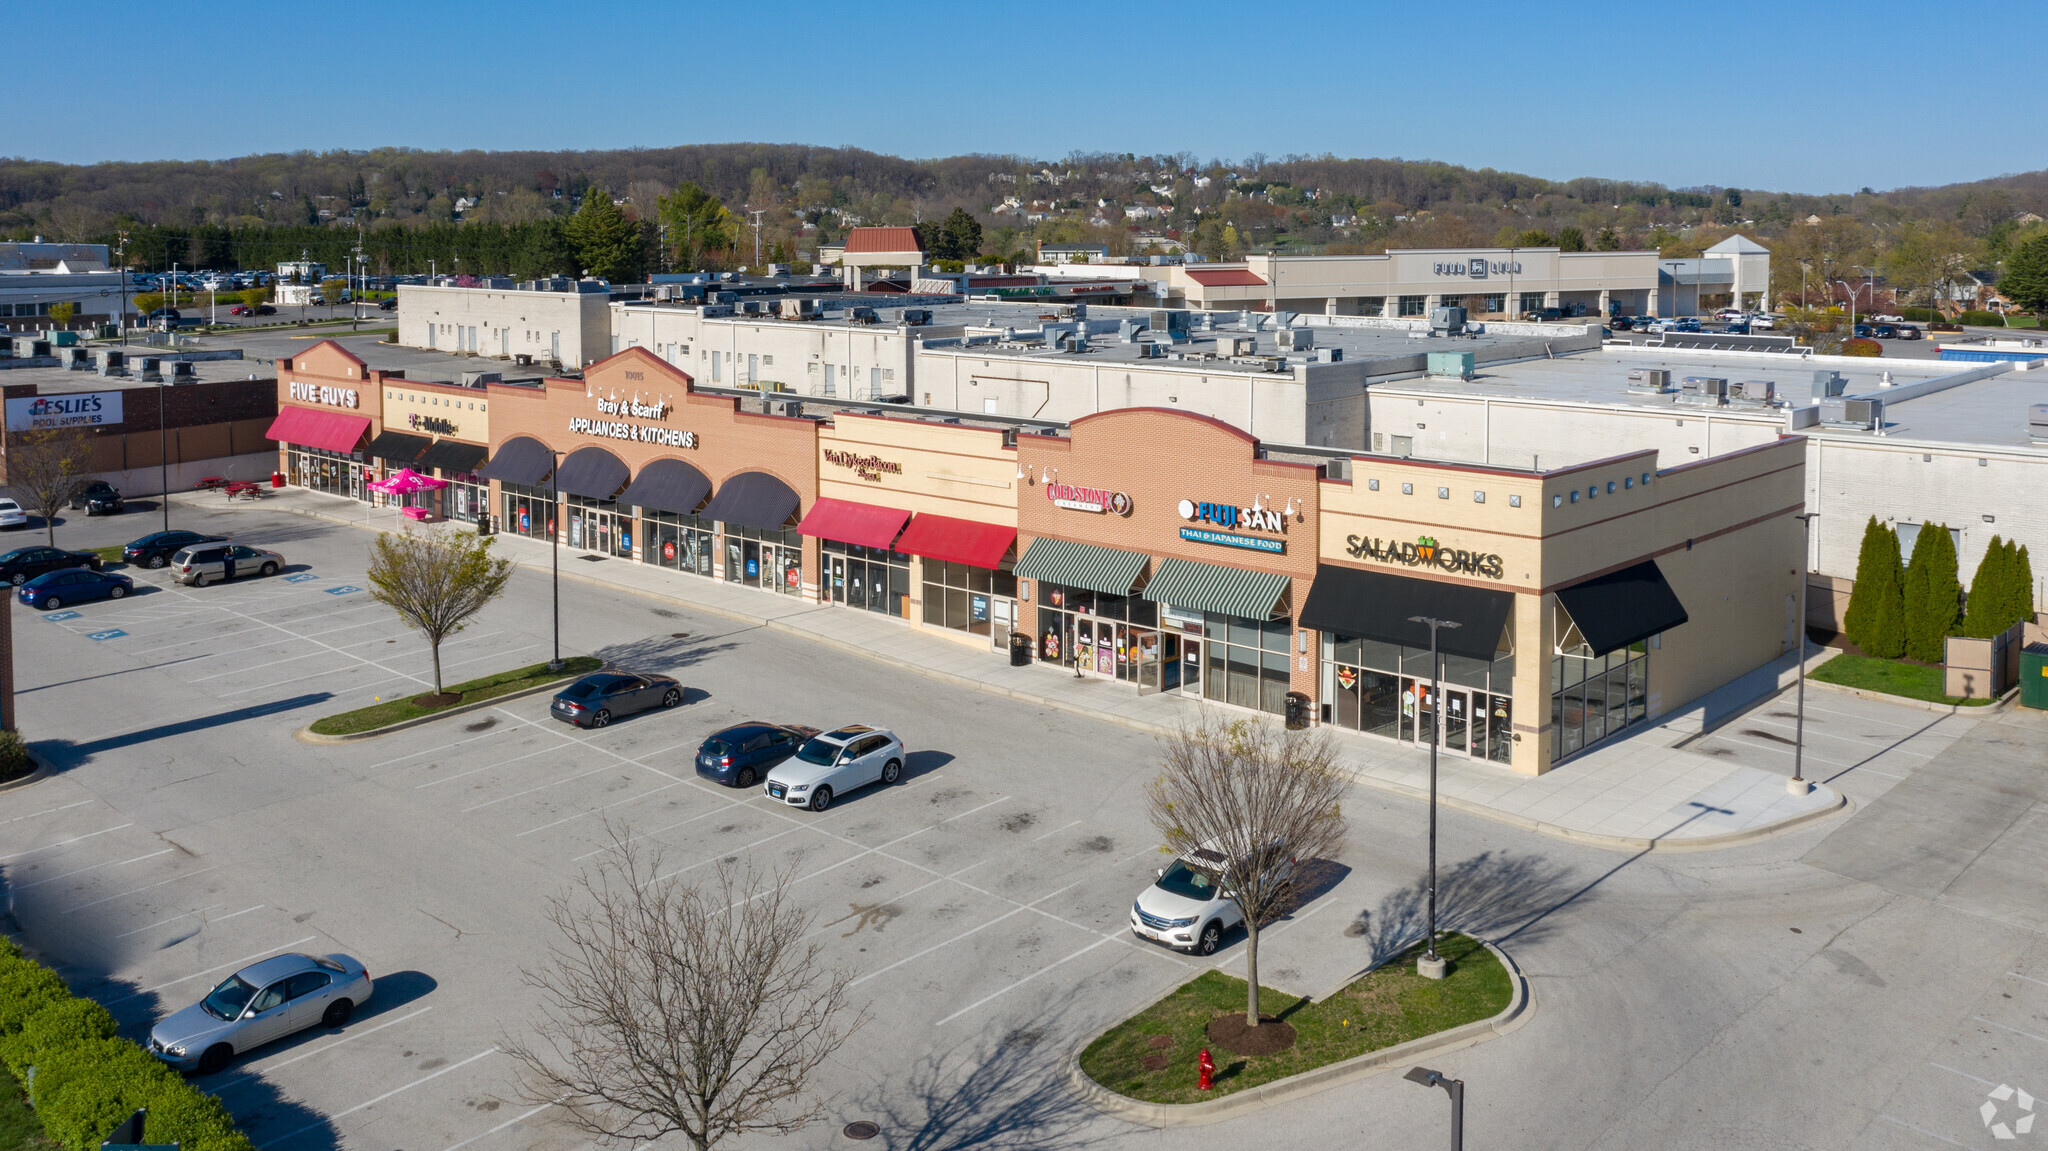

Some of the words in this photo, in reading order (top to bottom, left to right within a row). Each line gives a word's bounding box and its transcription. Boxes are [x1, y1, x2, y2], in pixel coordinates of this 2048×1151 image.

[1434, 262, 1463, 273] FOOD
[1491, 261, 1518, 272] LION
[625, 371, 644, 380] 10015
[33, 395, 102, 416] LESLIE'S
[289, 382, 316, 402] FIVE
[320, 386, 356, 408] GUYS
[598, 398, 619, 416] Bray
[621, 400, 629, 415] &
[632, 401, 662, 419] Scarff
[33, 418, 57, 427] POOL
[60, 415, 102, 426] SUPPLIES
[568, 417, 629, 439] APPLIANCES
[631, 425, 638, 440] &
[640, 426, 694, 448] KITCHENS
[823, 449, 839, 462] Van
[840, 451, 862, 469] Dyke
[869, 455, 897, 472] Bacon
[1047, 483, 1073, 501] COLD
[1075, 486, 1110, 509] STONE
[1198, 502, 1236, 527] FUJI
[1242, 508, 1282, 532] SAN
[1180, 529, 1202, 539] THAI
[1212, 533, 1256, 547] JAPANESE
[1257, 540, 1282, 550] FOOD
[1346, 534, 1504, 577] SALADWORKS
